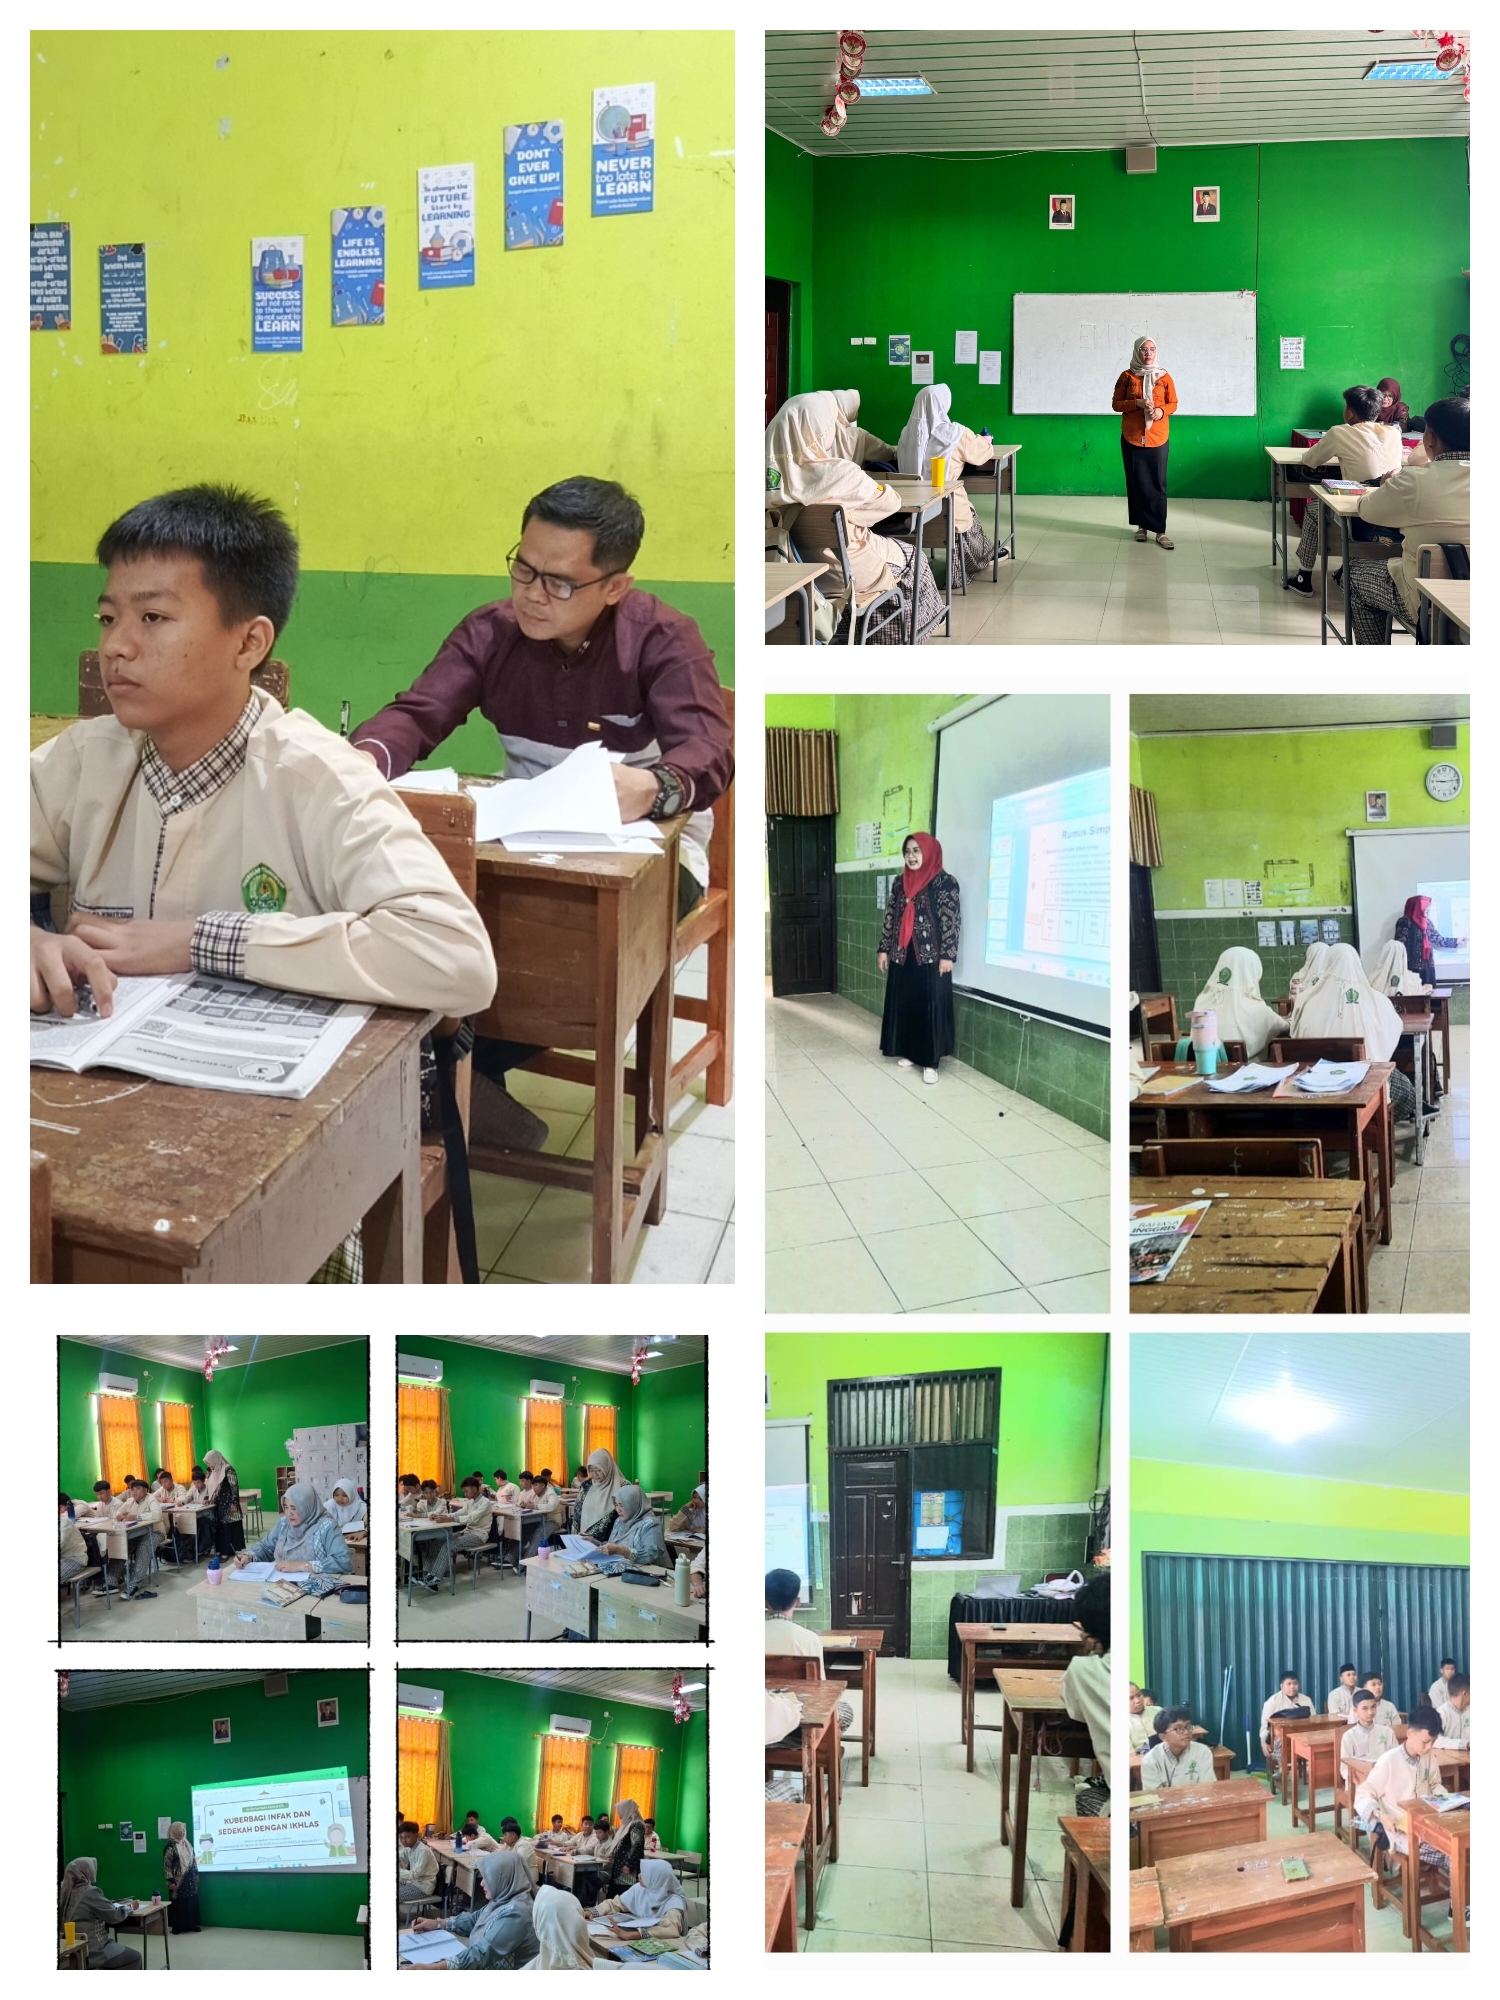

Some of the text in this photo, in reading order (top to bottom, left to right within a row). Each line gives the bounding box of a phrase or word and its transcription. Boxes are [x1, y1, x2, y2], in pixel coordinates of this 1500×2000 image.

[517, 148, 551, 161] DONT
[519, 161, 549, 173] EVER
[596, 156, 652, 173] NEVER
[509, 172, 560, 186] GIVE UP!
[596, 170, 651, 183] too late to
[432, 185, 456, 193] change
[596, 180, 652, 197] LEARN
[453, 203, 463, 211] by
[422, 210, 471, 222] LEARNING
[342, 238, 375, 247] LIFE IS
[337, 247, 380, 257] ENDLESS
[334, 258, 382, 268] LEARNING
[255, 291, 300, 300] SUCCESS
[255, 321, 300, 332] LEARN
[1062, 829, 1087, 840] Rumus
[1132, 1225, 1176, 1233] INGGRIS
[224, 1810, 311, 1825] KUBERBAGI INFAK DAN
[218, 1821, 319, 1836] SEDEKAH DENGAN IKHLAS
